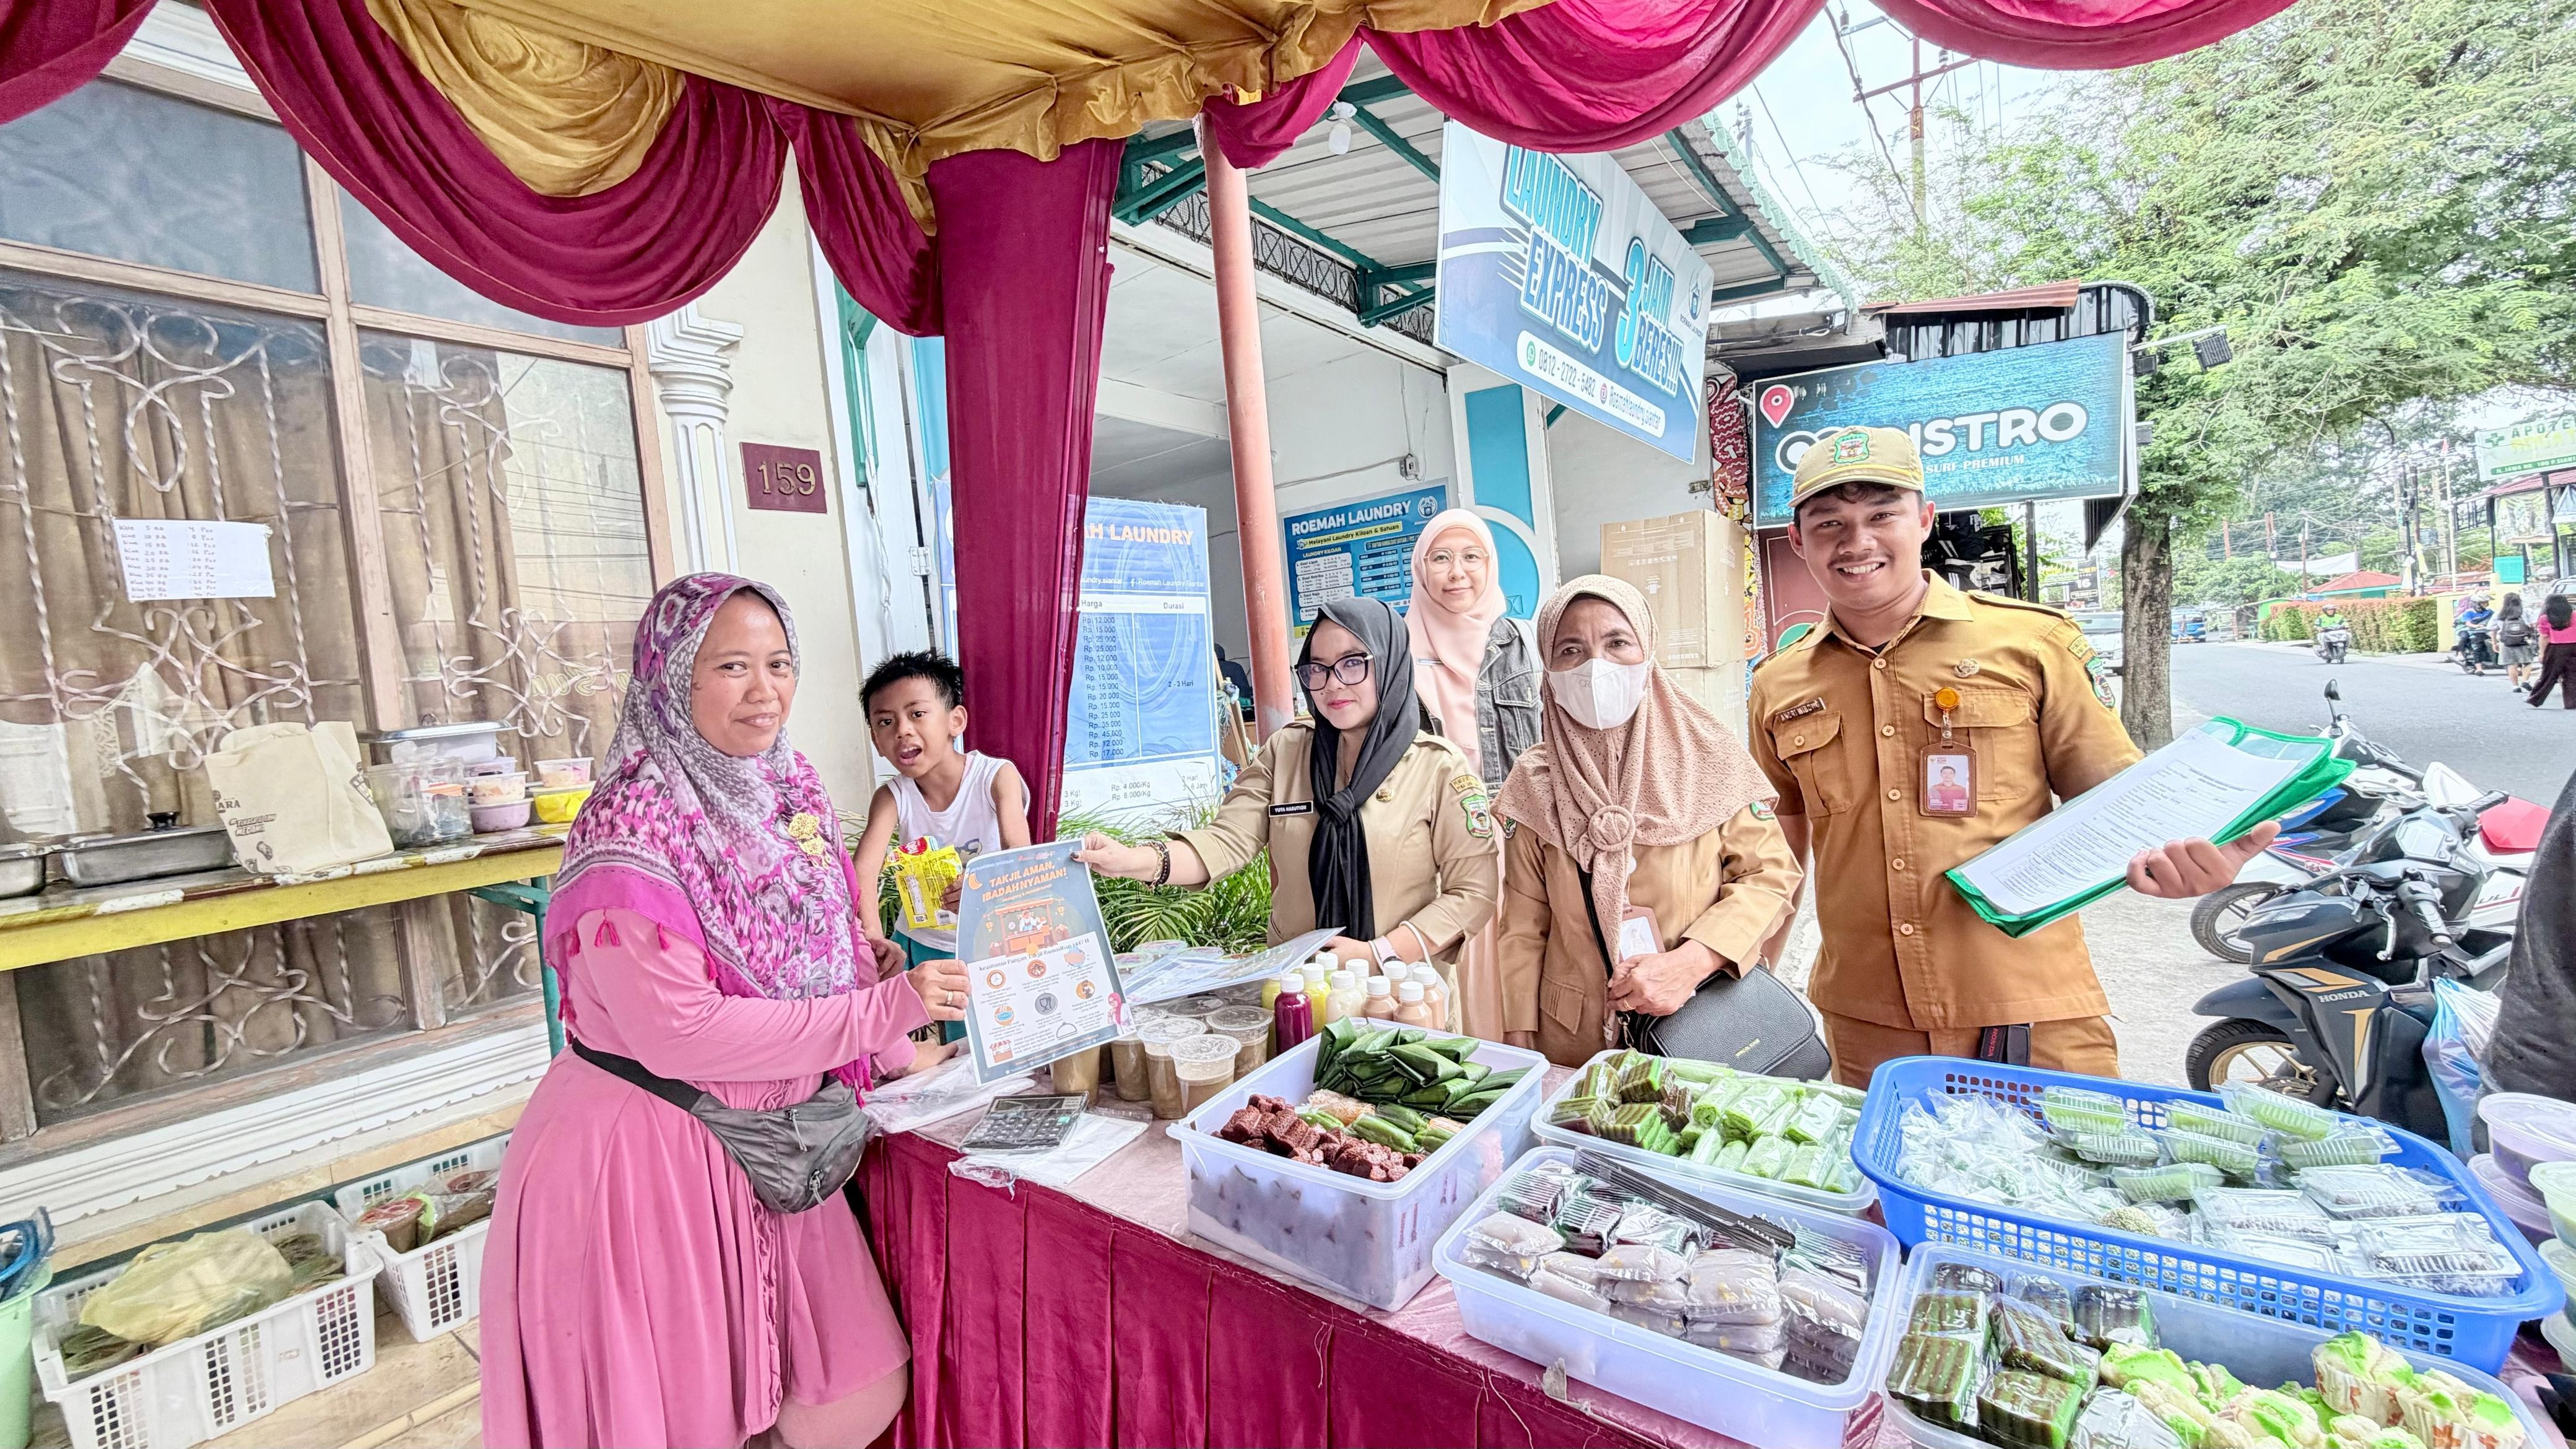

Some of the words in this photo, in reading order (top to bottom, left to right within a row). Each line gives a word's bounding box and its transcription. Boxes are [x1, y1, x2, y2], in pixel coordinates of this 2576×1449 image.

[1505, 145, 1601, 266] LAUNDRY
[1523, 231, 1606, 349] EXPRESS
[1616, 243, 1645, 363] 3
[1642, 260, 1673, 330] JAM
[1538, 349, 1556, 377] 0812
[1560, 363, 1577, 388] 2722
[1580, 372, 1596, 398] 5482
[758, 461, 816, 495] 159
[1926, 461, 1958, 475] SURF
[1962, 455, 2025, 470] PREMIUM
[1292, 514, 1346, 536] ROEMAH
[1348, 500, 1411, 524] LAUNDRY
[1110, 524, 1194, 546] LAUNDRY
[1308, 536, 1331, 546] Melayani
[1332, 532, 1354, 543] Laundry
[1355, 528, 1373, 538] Kiloan
[1380, 524, 1399, 533] Satuan
[1081, 600, 1103, 609] Harga
[982, 884, 1022, 902] IBADAH
[990, 873, 1022, 888] TAKJIL
[2317, 989, 2372, 1003] HONDA
[1986, 1028, 1999, 1058] HONDA
